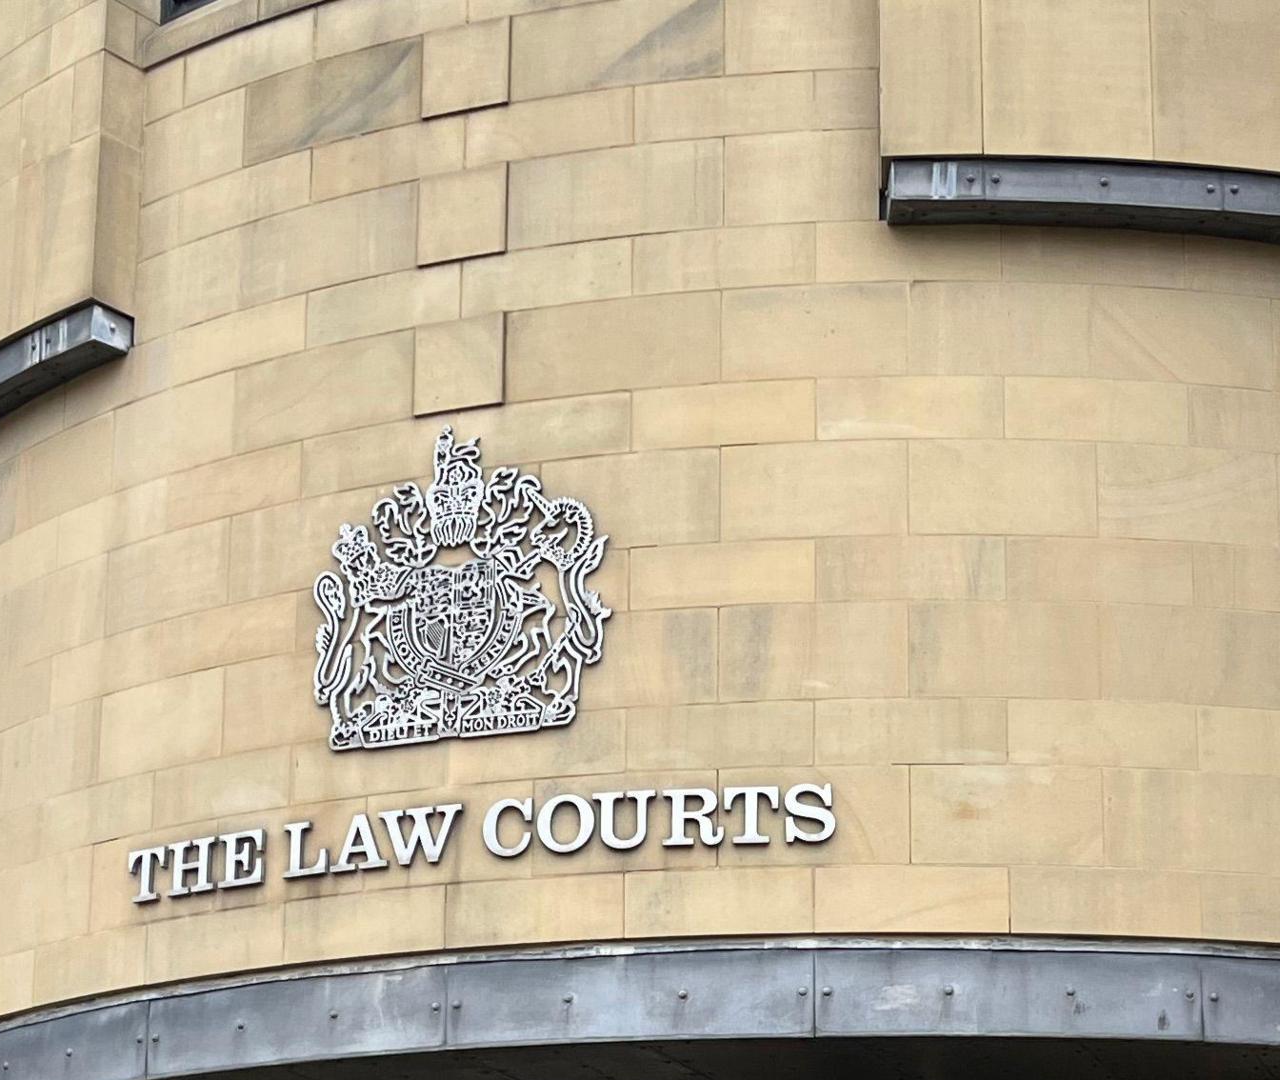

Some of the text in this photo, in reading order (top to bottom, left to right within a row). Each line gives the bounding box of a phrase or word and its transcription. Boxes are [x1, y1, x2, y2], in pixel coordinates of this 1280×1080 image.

[370, 713, 540, 742] DIEU ET MON DROIT
[128, 783, 837, 904] THE LAW COURTS
